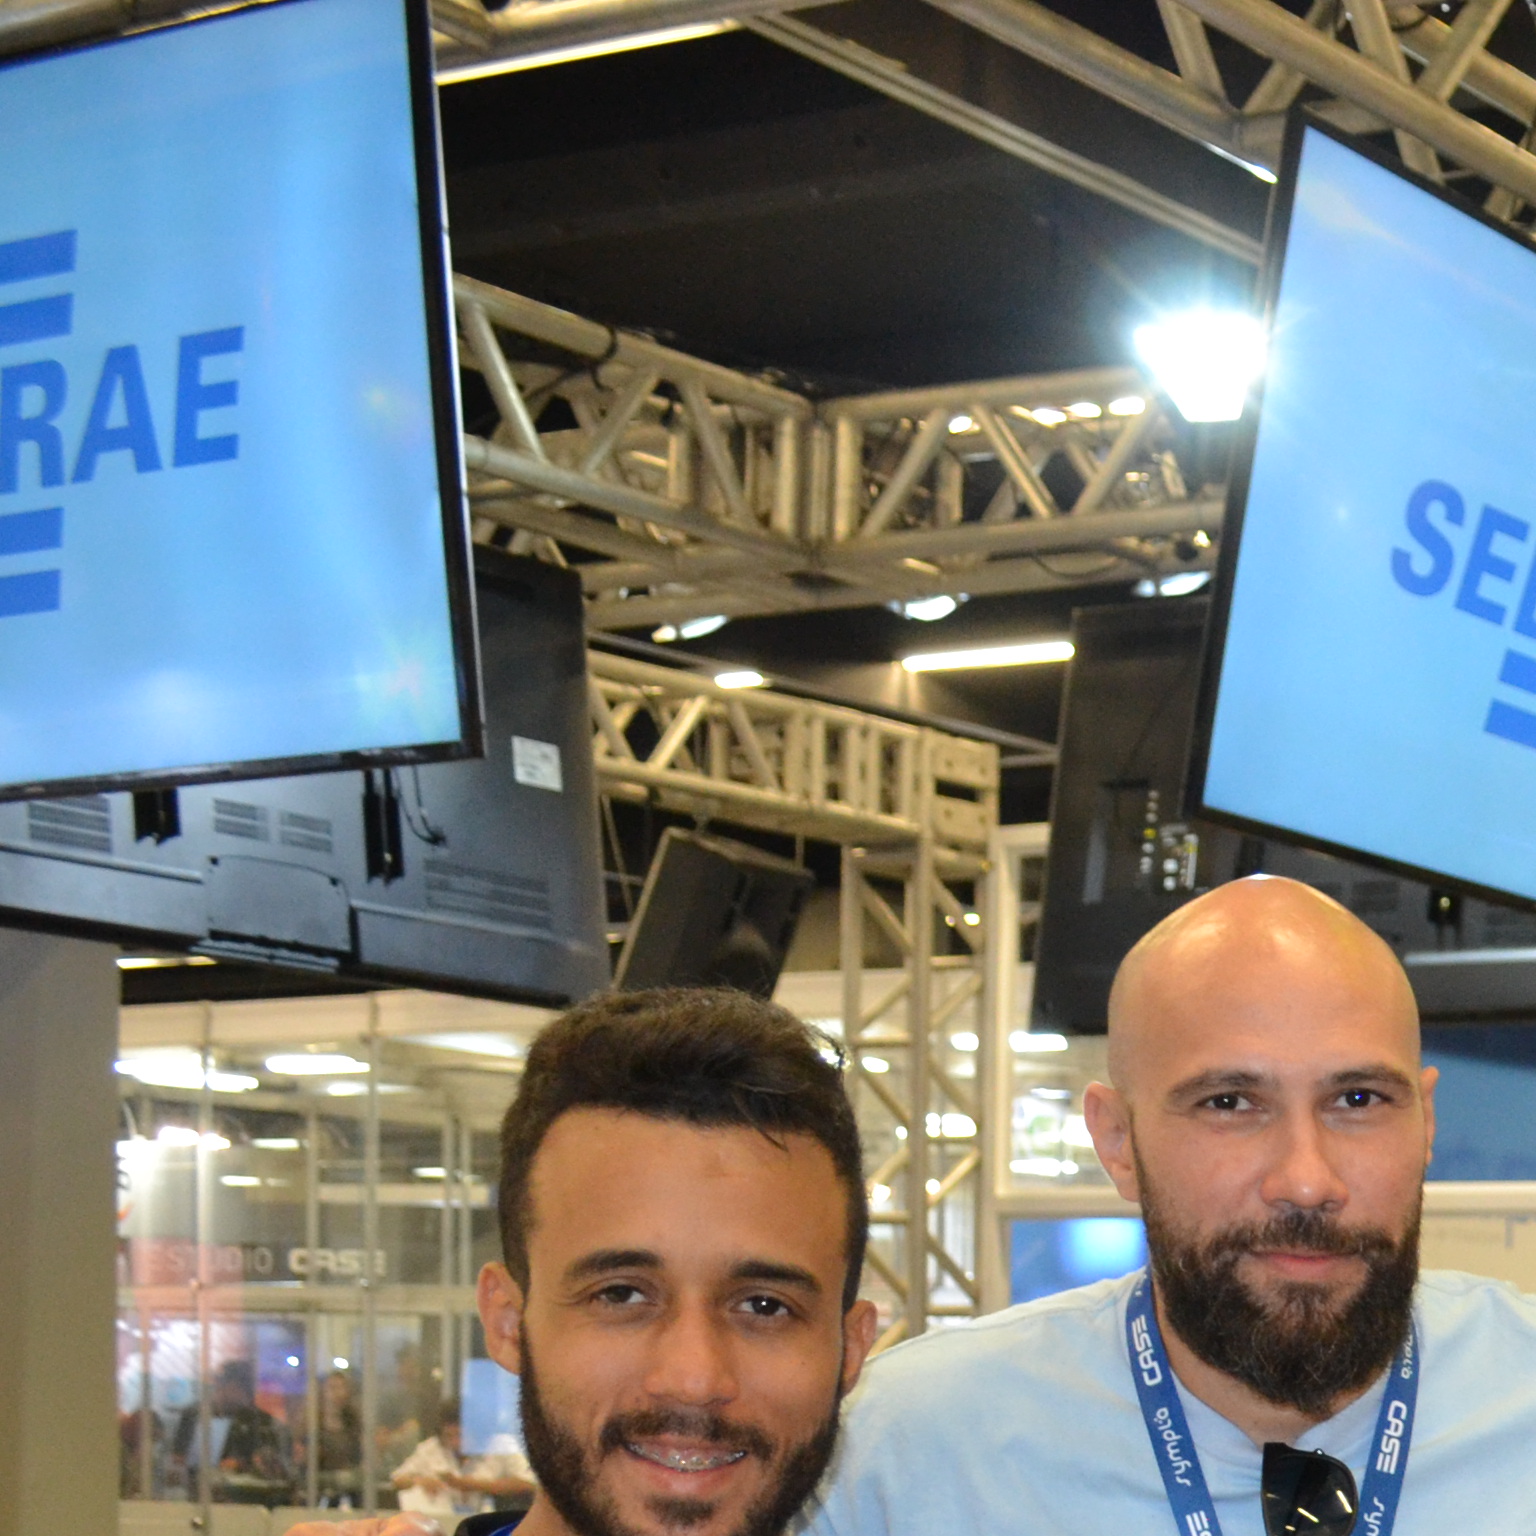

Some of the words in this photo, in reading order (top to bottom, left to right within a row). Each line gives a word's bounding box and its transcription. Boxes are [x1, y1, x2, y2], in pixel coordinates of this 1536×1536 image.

[0, 325, 245, 496] RAE
[1131, 1314, 1163, 1386] CASE
[1375, 1399, 1408, 1475] CASE
